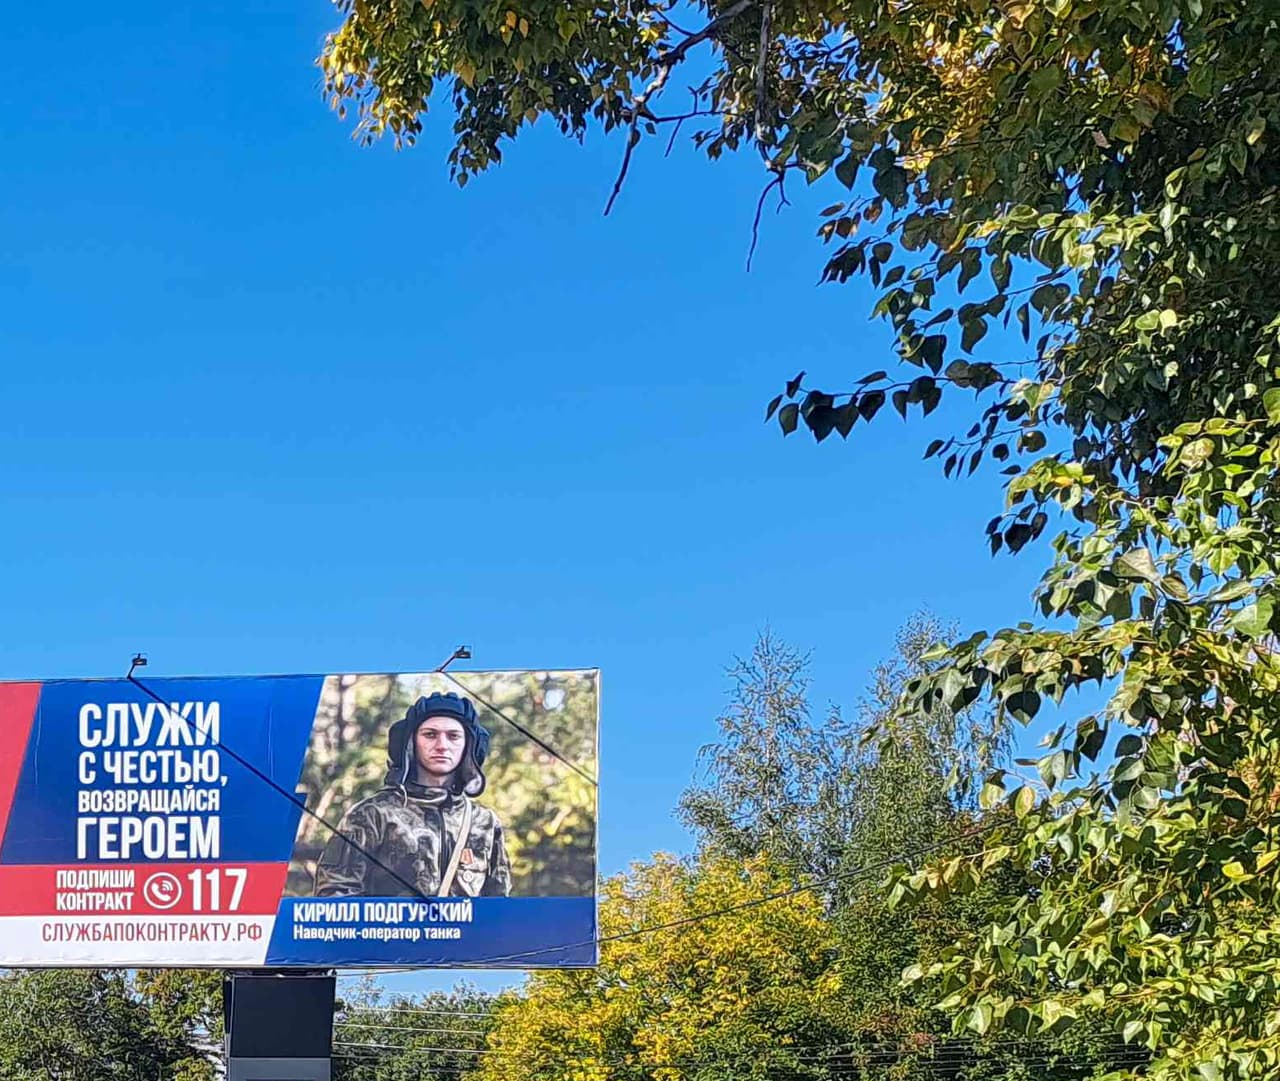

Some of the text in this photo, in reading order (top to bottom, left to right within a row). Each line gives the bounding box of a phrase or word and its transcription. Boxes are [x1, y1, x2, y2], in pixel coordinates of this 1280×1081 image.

[79, 701, 220, 747] СЛУЖИ
[79, 750, 228, 787] С ЧЕСТЬЮ,
[78, 784, 220, 814] ВОЗВРАЩАЙСЯ
[77, 816, 220, 859] ГЕРОЕМ
[56, 869, 134, 890] ПОДПИШИ
[187, 868, 248, 911] 117
[56, 892, 134, 911] КОНТРАКТ
[293, 899, 473, 923] КИРИЛЛ ПОДГУРСКИЙ
[42, 922, 263, 942] СЛУЖБАПОКОНТРАКТУ.РФ
[293, 924, 461, 942] Наводчик-оператор танка
